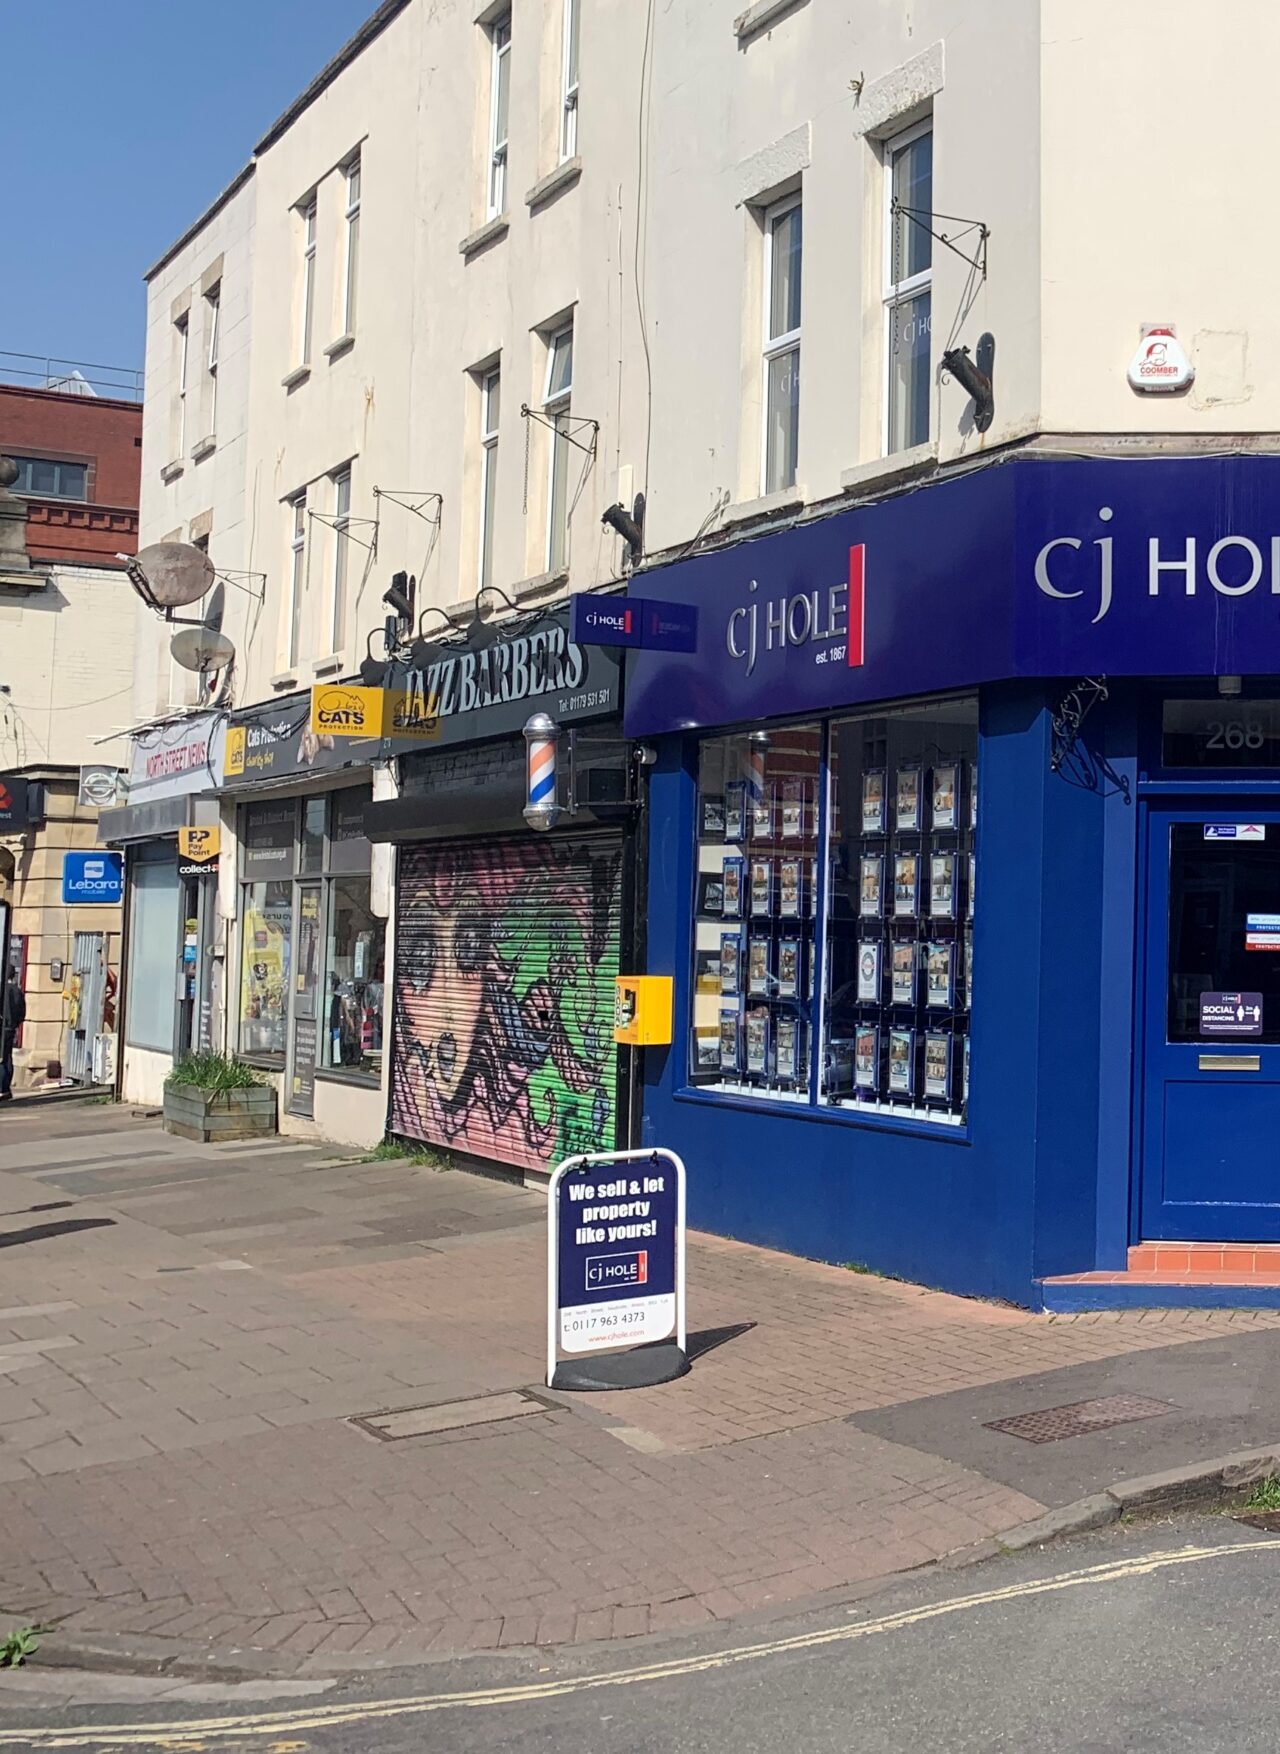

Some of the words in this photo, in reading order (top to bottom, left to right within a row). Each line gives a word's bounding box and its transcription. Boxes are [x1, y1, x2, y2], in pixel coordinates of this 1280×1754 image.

[1140, 366, 1179, 375] COOMBER
[1034, 506, 1114, 624] cj
[585, 611, 597, 627] cj
[599, 616, 625, 627] HOLE
[726, 579, 758, 678] cj
[765, 583, 848, 651] HOLE
[815, 650, 828, 665] est.
[829, 645, 846, 663] 1867
[402, 657, 456, 727] JAZZ
[459, 626, 584, 713] BARBERS
[558, 698, 569, 713] Tel:
[570, 693, 587, 711] 01179
[587, 691, 598, 708] 531
[317, 709, 365, 725] CATS
[247, 728, 260, 748] Cats
[1205, 720, 1265, 750] 268
[146, 752, 164, 779] NORTH
[165, 745, 188, 774] STREET
[188, 740, 206, 769] NEWS
[68, 879, 119, 890] Lebara
[1202, 1005, 1235, 1014] SOCIAL
[568, 1183, 595, 1202] We
[597, 1179, 627, 1199] sell
[629, 1180, 641, 1195] &
[643, 1176, 665, 1194] let
[582, 1200, 651, 1224] property
[575, 1226, 606, 1245] like
[607, 1219, 657, 1243] yours!
[588, 1262, 603, 1283] cj
[605, 1263, 638, 1278] HOLE
[572, 1318, 597, 1331] 0117
[600, 1316, 618, 1327] 963
[621, 1312, 646, 1323] 4373
[588, 1329, 646, 1343] www.cjhole.com
